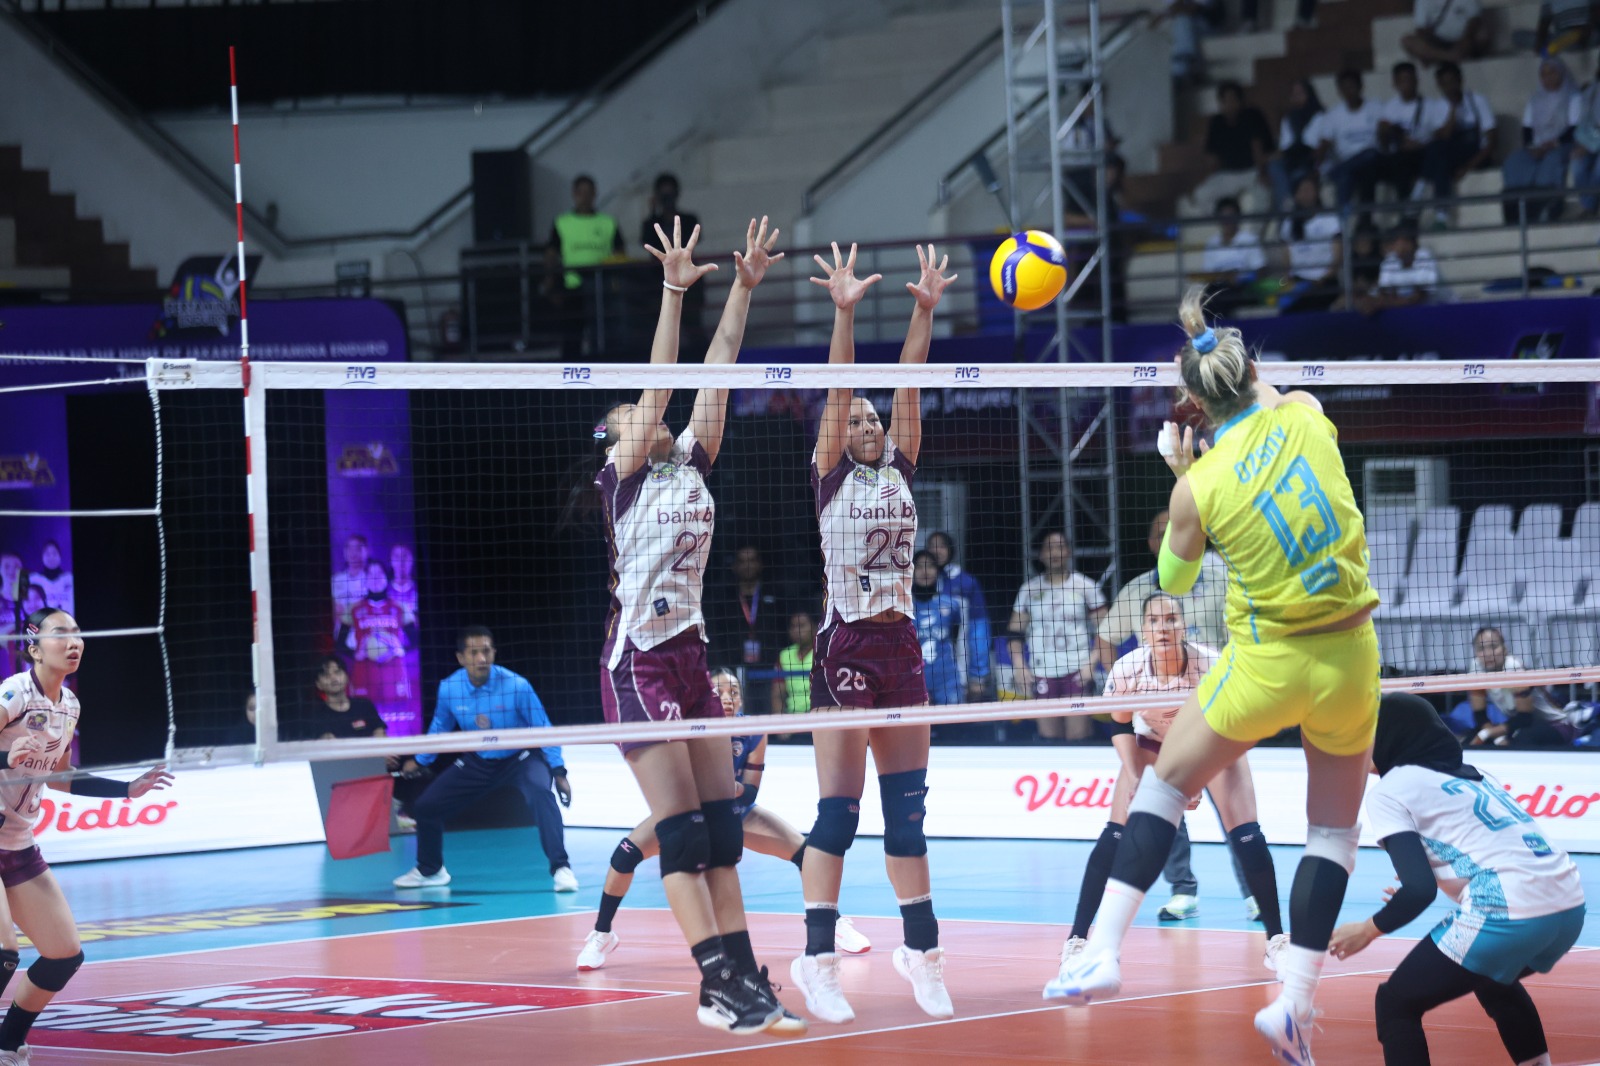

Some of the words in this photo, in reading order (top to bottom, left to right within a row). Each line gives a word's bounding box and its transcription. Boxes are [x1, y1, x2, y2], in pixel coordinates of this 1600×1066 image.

[347, 366, 376, 379] FIVB
[563, 367, 591, 379] FIVB
[765, 367, 792, 379] FIVB
[955, 367, 980, 378] FIVB
[1134, 366, 1157, 377] FIVB
[1302, 365, 1325, 376] FIVB
[657, 507, 699, 525] bank
[849, 502, 897, 520] bank
[1252, 454, 1342, 569] 13
[862, 527, 915, 572] 25
[1014, 771, 1115, 812] Vidi
[94, 985, 545, 1019] Kuku
